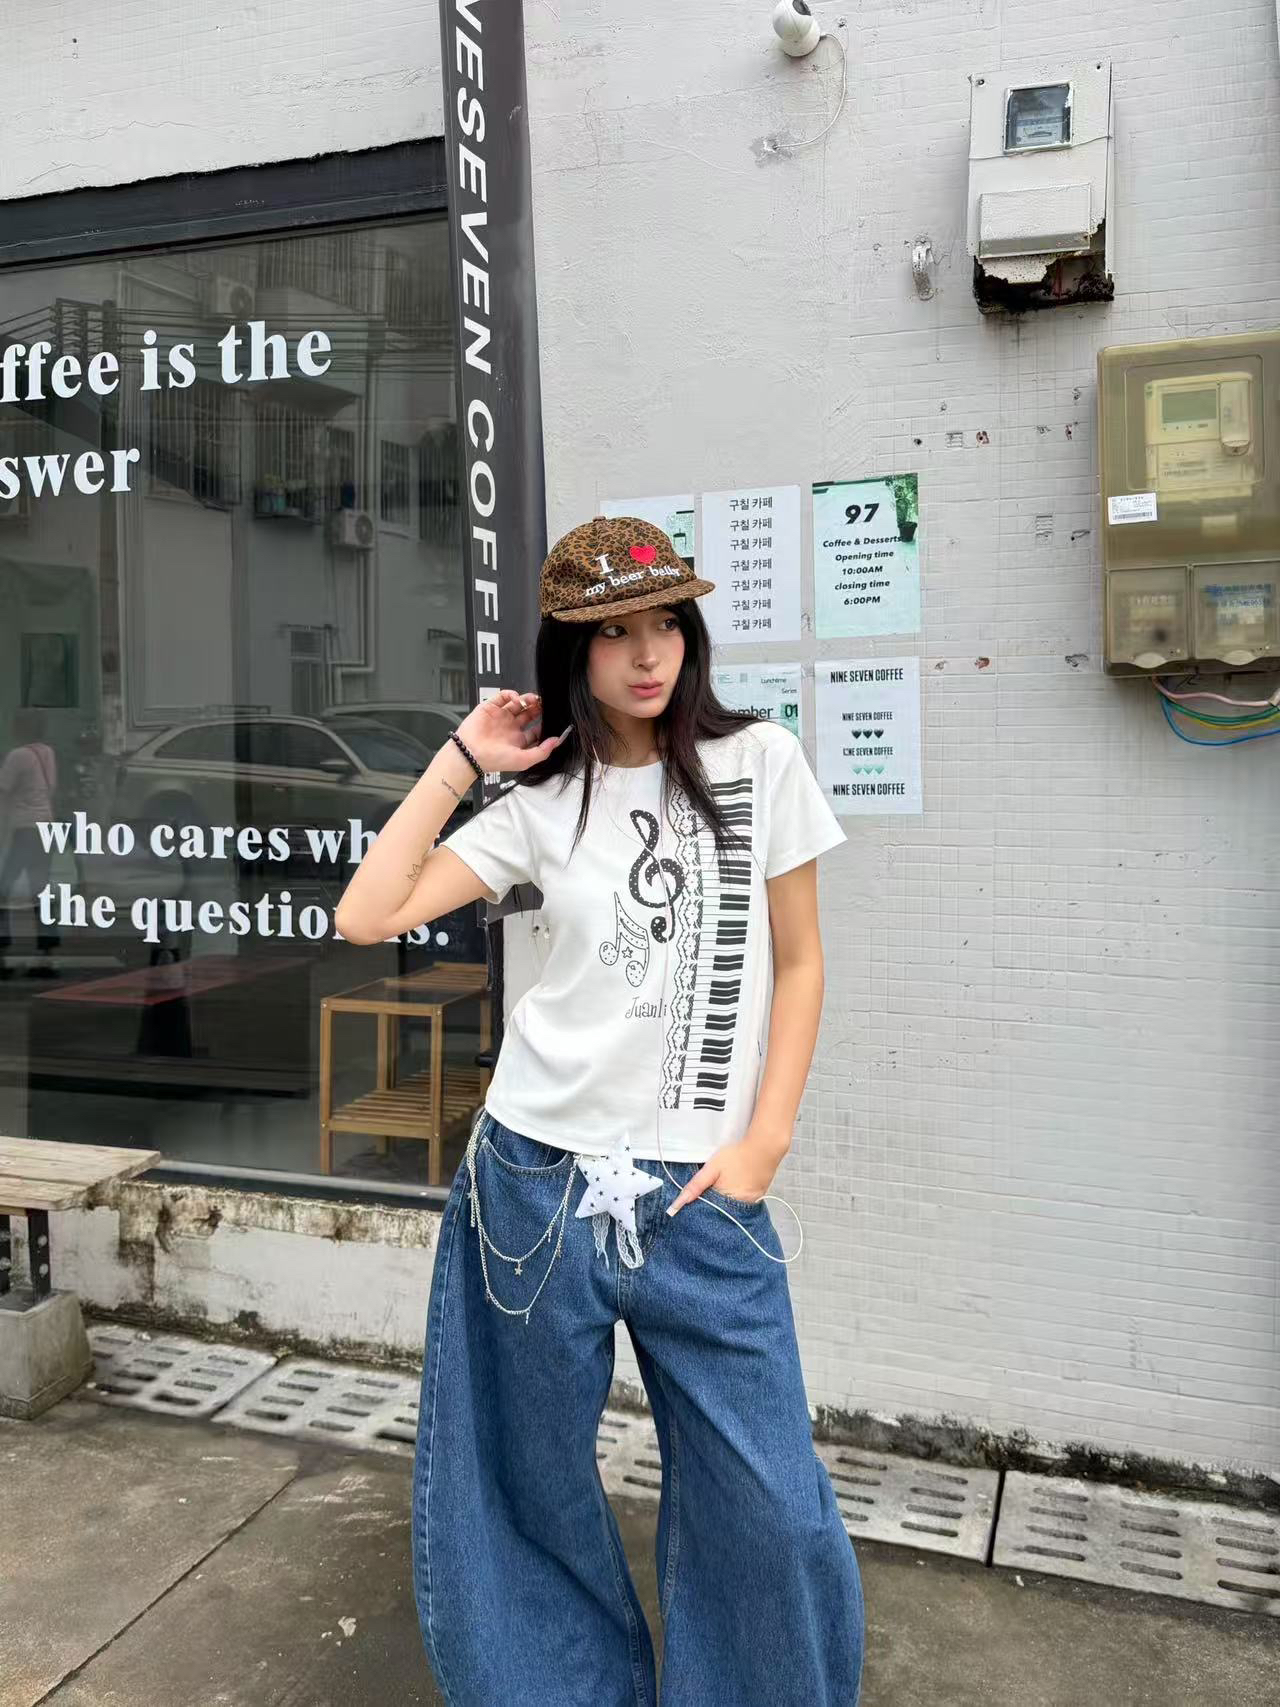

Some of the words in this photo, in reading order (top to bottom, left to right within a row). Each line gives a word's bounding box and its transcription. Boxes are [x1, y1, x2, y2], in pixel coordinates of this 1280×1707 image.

[140, 329, 197, 391] is
[217, 320, 332, 384] the
[752, 496, 773, 509] 카페
[845, 503, 880, 525] 97
[752, 517, 773, 529] 카페
[752, 536, 773, 549] 카페
[822, 538, 852, 548] Coffee
[854, 538, 862, 546] &
[863, 535, 903, 545] Desserts
[835, 552, 872, 563] Opening
[874, 550, 894, 559] time
[595, 553, 614, 575] I
[752, 558, 772, 570] 카페
[842, 566, 883, 576] 10:00AM
[585, 582, 606, 597] my
[608, 569, 645, 586] beer
[752, 578, 772, 590] 카페
[834, 581, 867, 591] closing
[869, 580, 890, 589] time
[752, 598, 772, 610] 카페
[843, 596, 881, 606] 6:00PM
[752, 618, 772, 629] 카페
[830, 671, 848, 683] NINE
[849, 669, 874, 683] SEVEN
[875, 668, 904, 681] COFFEE
[784, 703, 799, 718] 01
[842, 712, 854, 721] NINE
[855, 711, 873, 721] SEVEN
[873, 711, 893, 720] COFFEE
[856, 747, 873, 756] SEVEN
[874, 747, 893, 756] COFFEE
[833, 784, 850, 796] NINE
[851, 783, 876, 796] SEVEN
[877, 783, 905, 795] COFFEE
[36, 811, 135, 856] who
[150, 824, 291, 862] cares
[37, 883, 116, 929] the
[131, 890, 346, 943] questio
